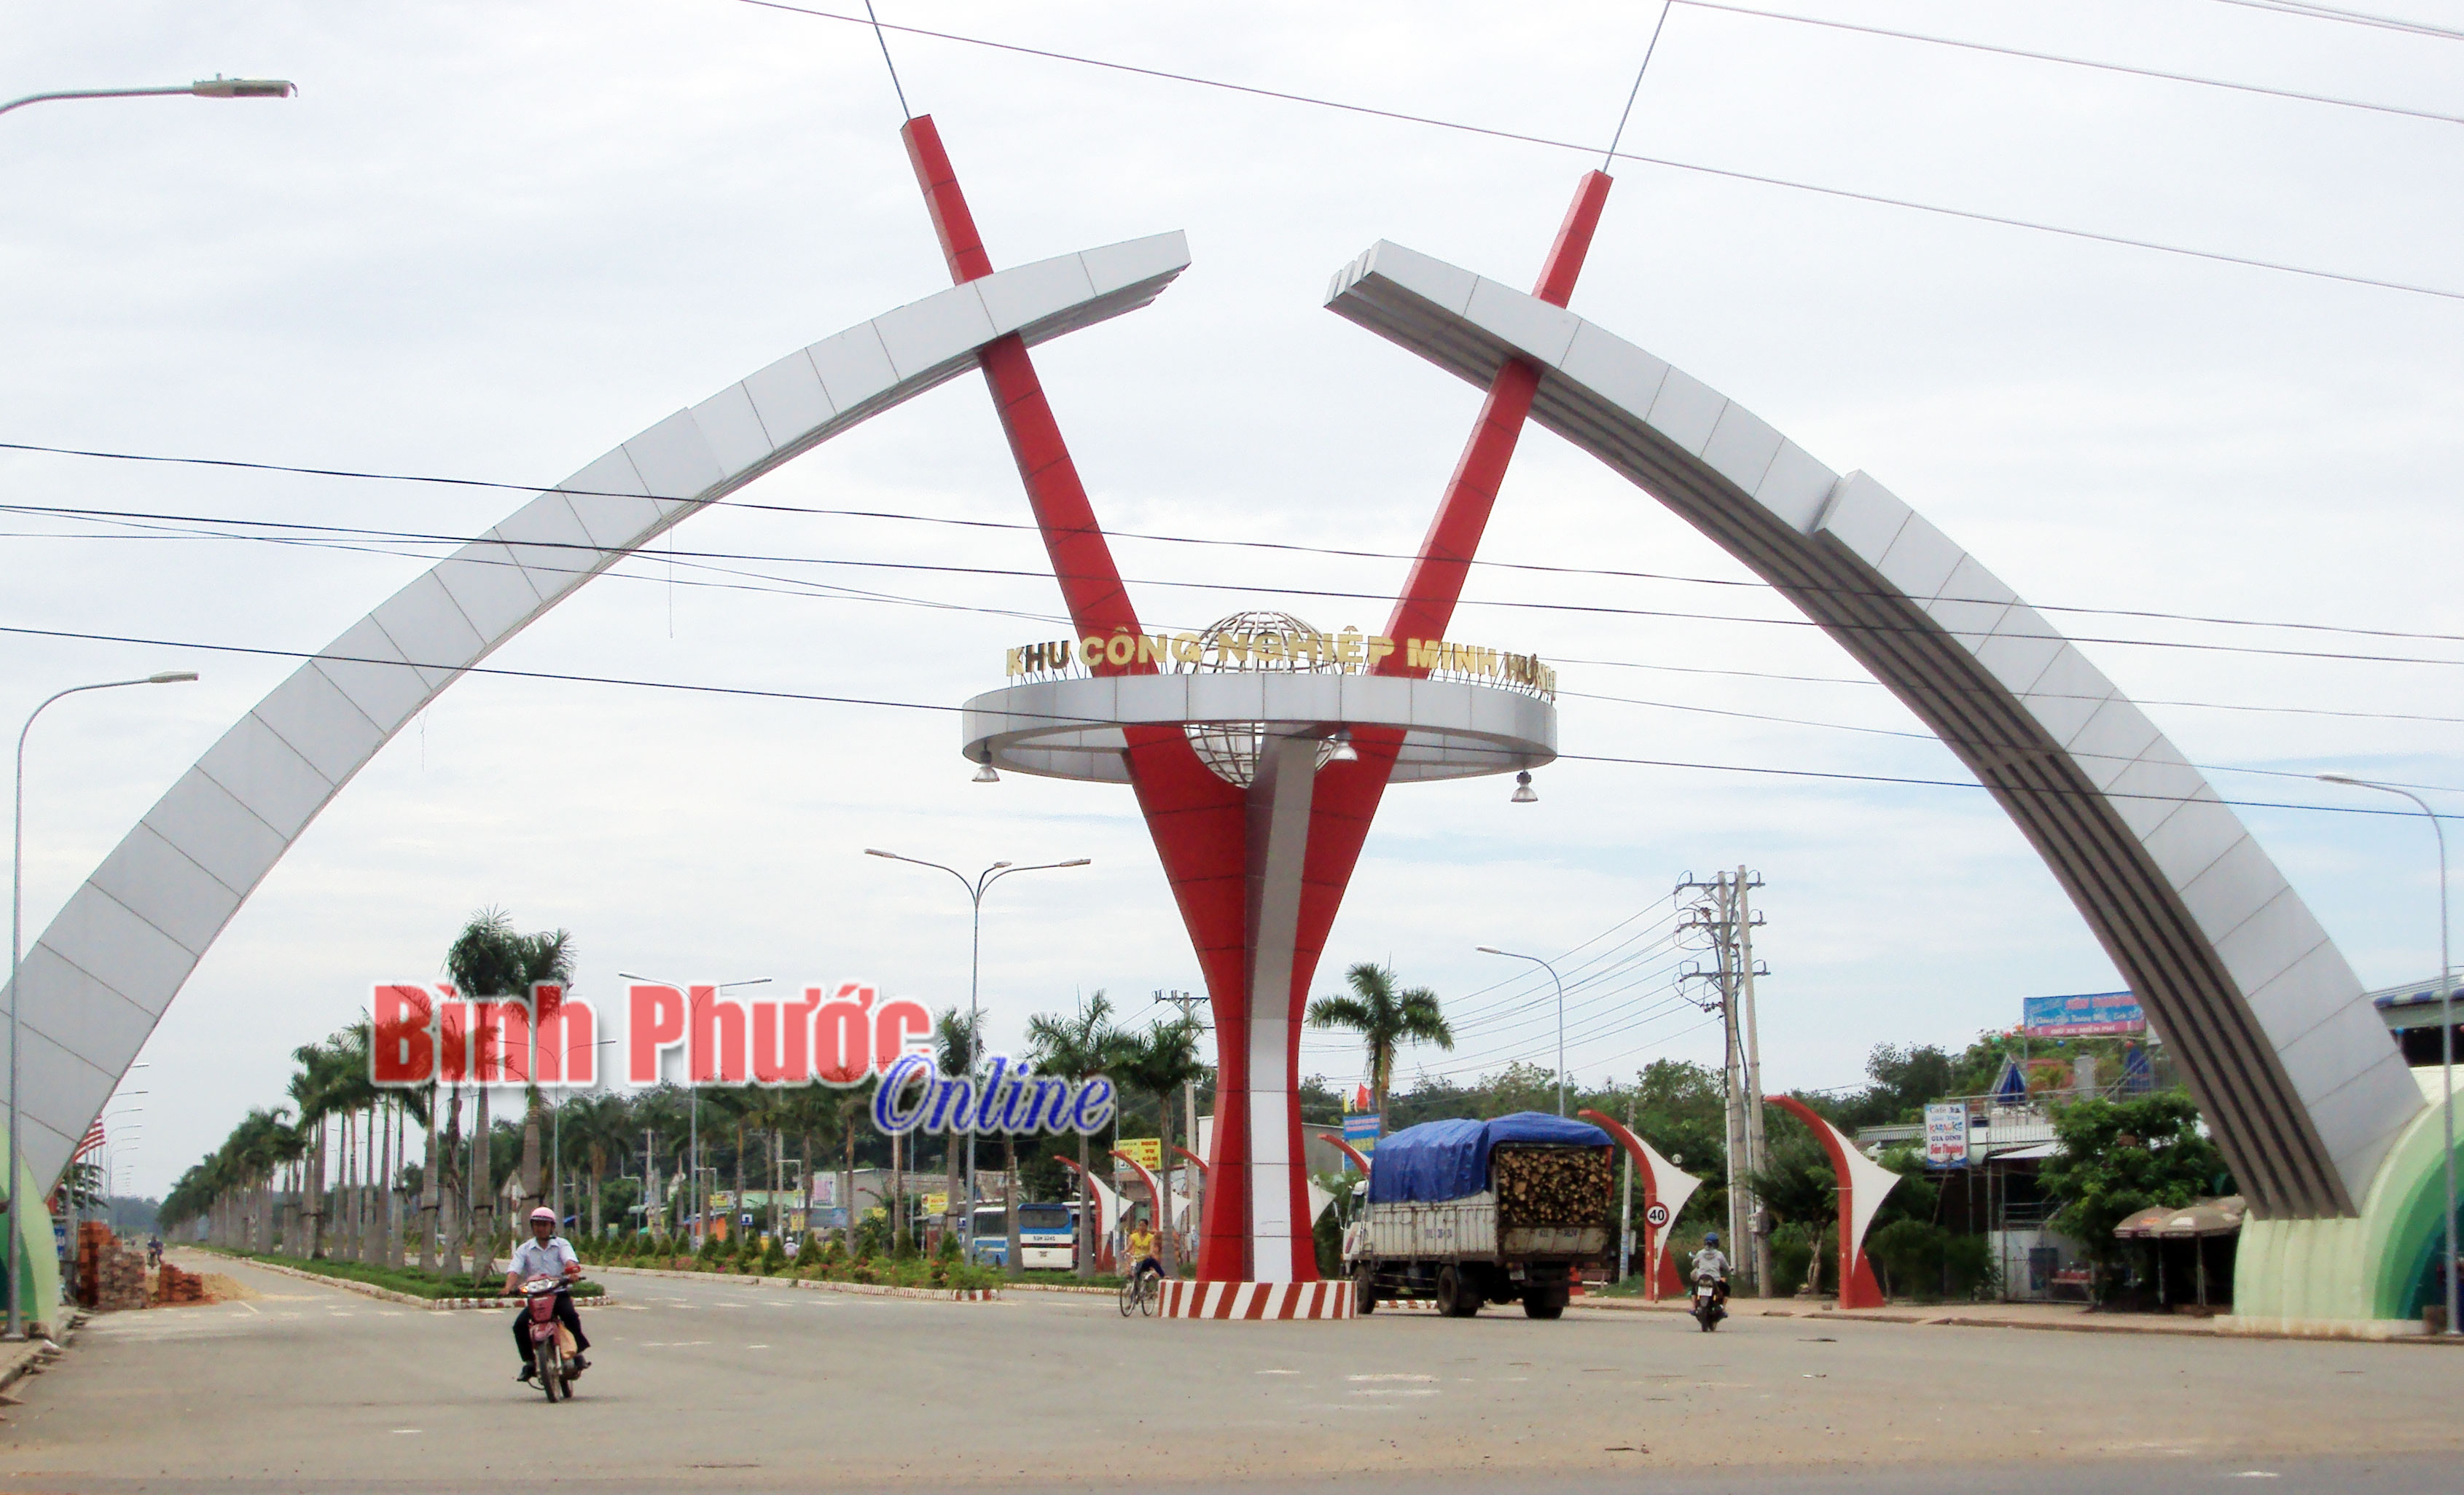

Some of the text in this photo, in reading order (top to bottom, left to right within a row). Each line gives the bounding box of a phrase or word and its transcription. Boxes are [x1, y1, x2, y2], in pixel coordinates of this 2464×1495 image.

[1006, 640, 1071, 677] KHU
[1079, 626, 1202, 667] CÔNG
[1217, 625, 1395, 672] NGHIỆP
[1407, 637, 1496, 677] MINH
[1649, 1209, 1665, 1221] 40
